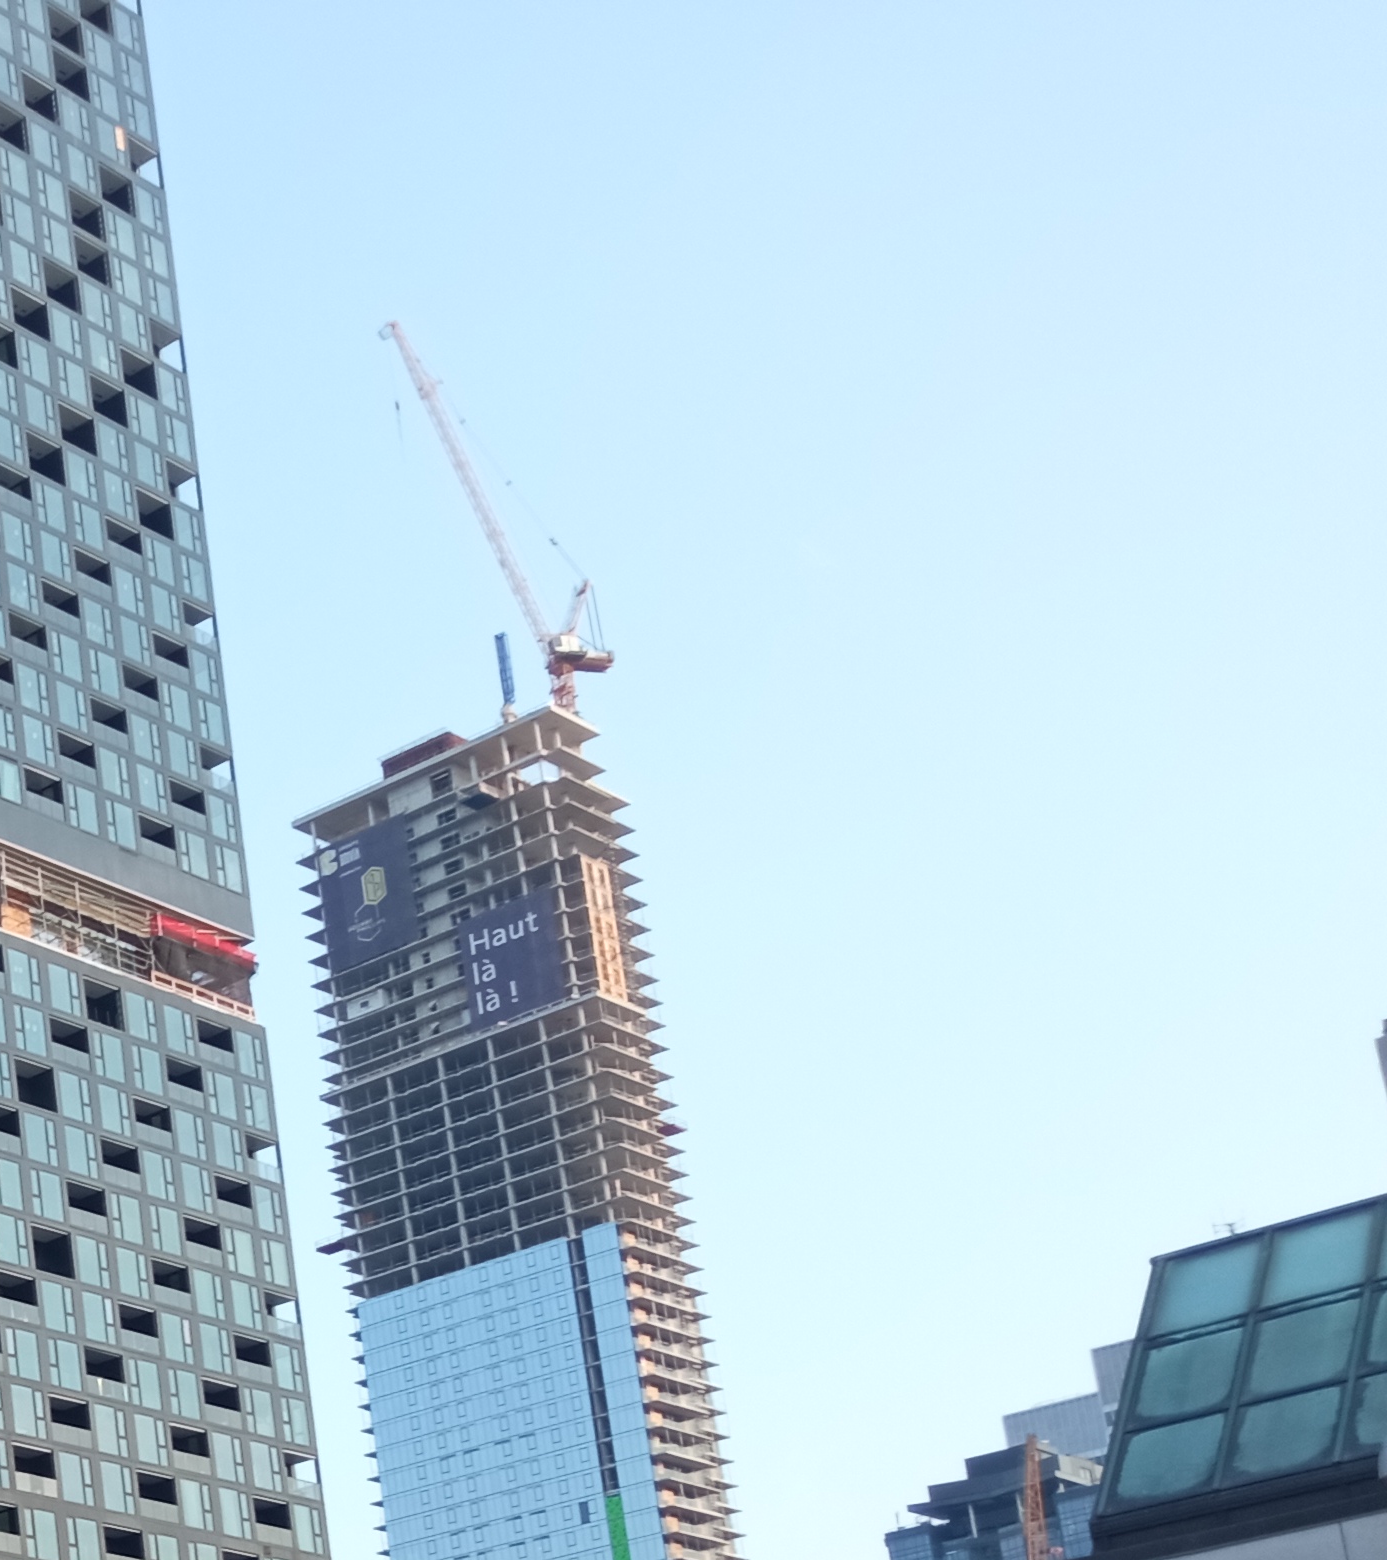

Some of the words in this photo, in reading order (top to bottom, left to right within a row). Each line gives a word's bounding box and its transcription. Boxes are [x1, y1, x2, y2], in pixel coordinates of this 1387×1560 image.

[468, 911, 539, 955] Haut
[472, 959, 497, 985] là
[476, 988, 501, 1015] là
[509, 980, 519, 1003] !
